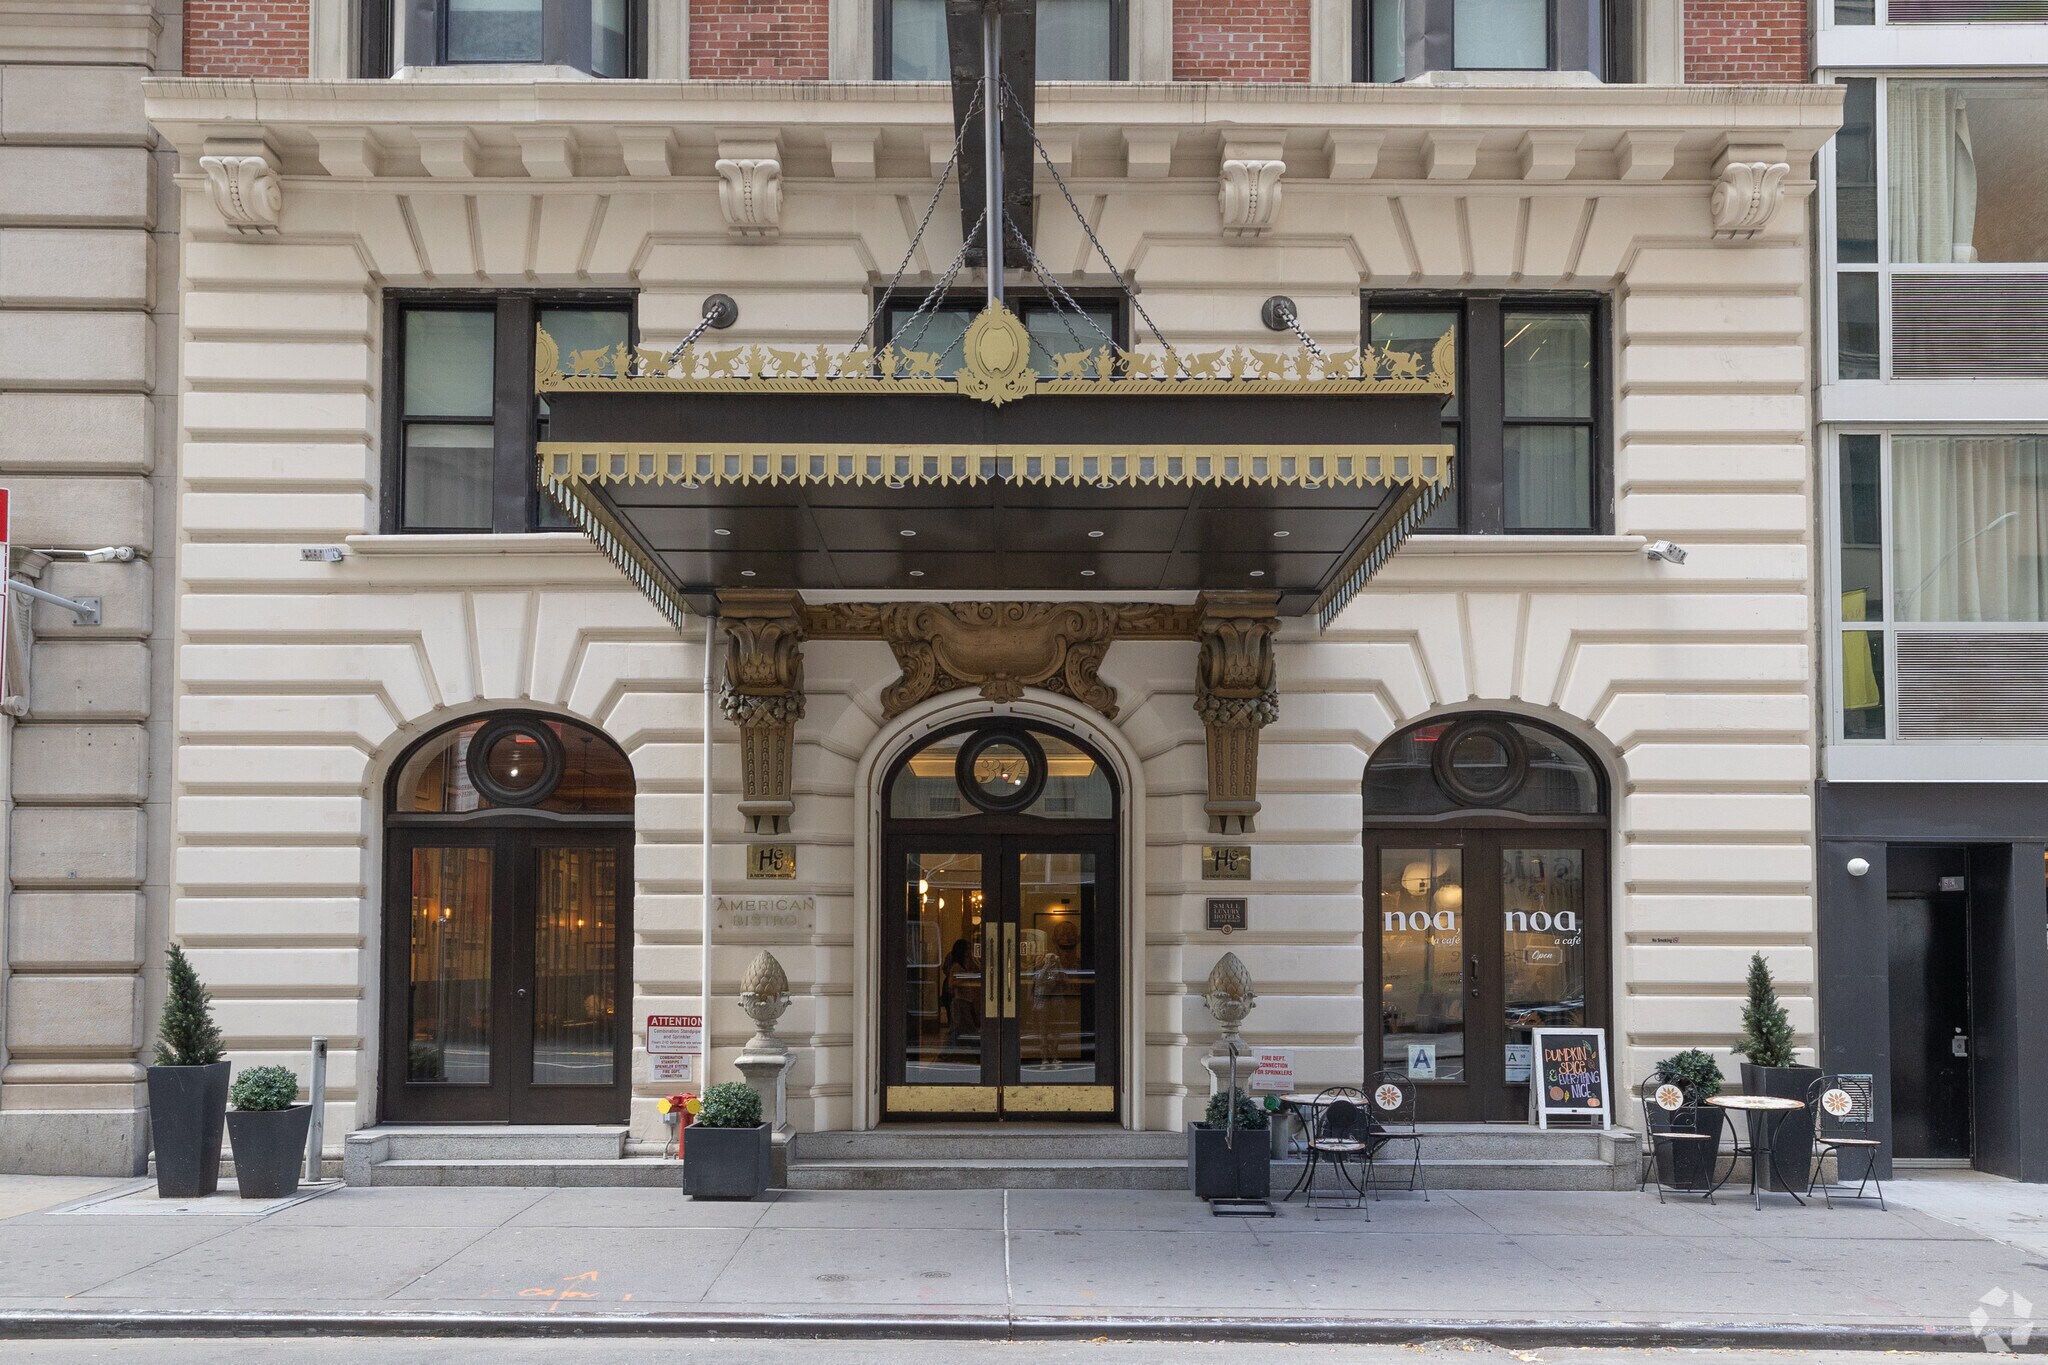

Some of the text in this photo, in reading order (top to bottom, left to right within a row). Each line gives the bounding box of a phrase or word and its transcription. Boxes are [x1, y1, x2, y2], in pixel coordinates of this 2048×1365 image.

[975, 759, 1026, 784] 34
[716, 900, 814, 912] AMERICAN
[733, 914, 797, 926] BISTRO
[1442, 936, 1460, 946] café
[1562, 936, 1582, 946] café
[1532, 950, 1552, 960] Open
[651, 1017, 702, 1026] ATTENTION
[1413, 1048, 1431, 1068] A
[1508, 1052, 1517, 1061] A
[1545, 1046, 1587, 1062] PUMPKIN
[1549, 1069, 1600, 1085] & EVERYTHING
[1571, 1083, 1592, 1098] NICE
